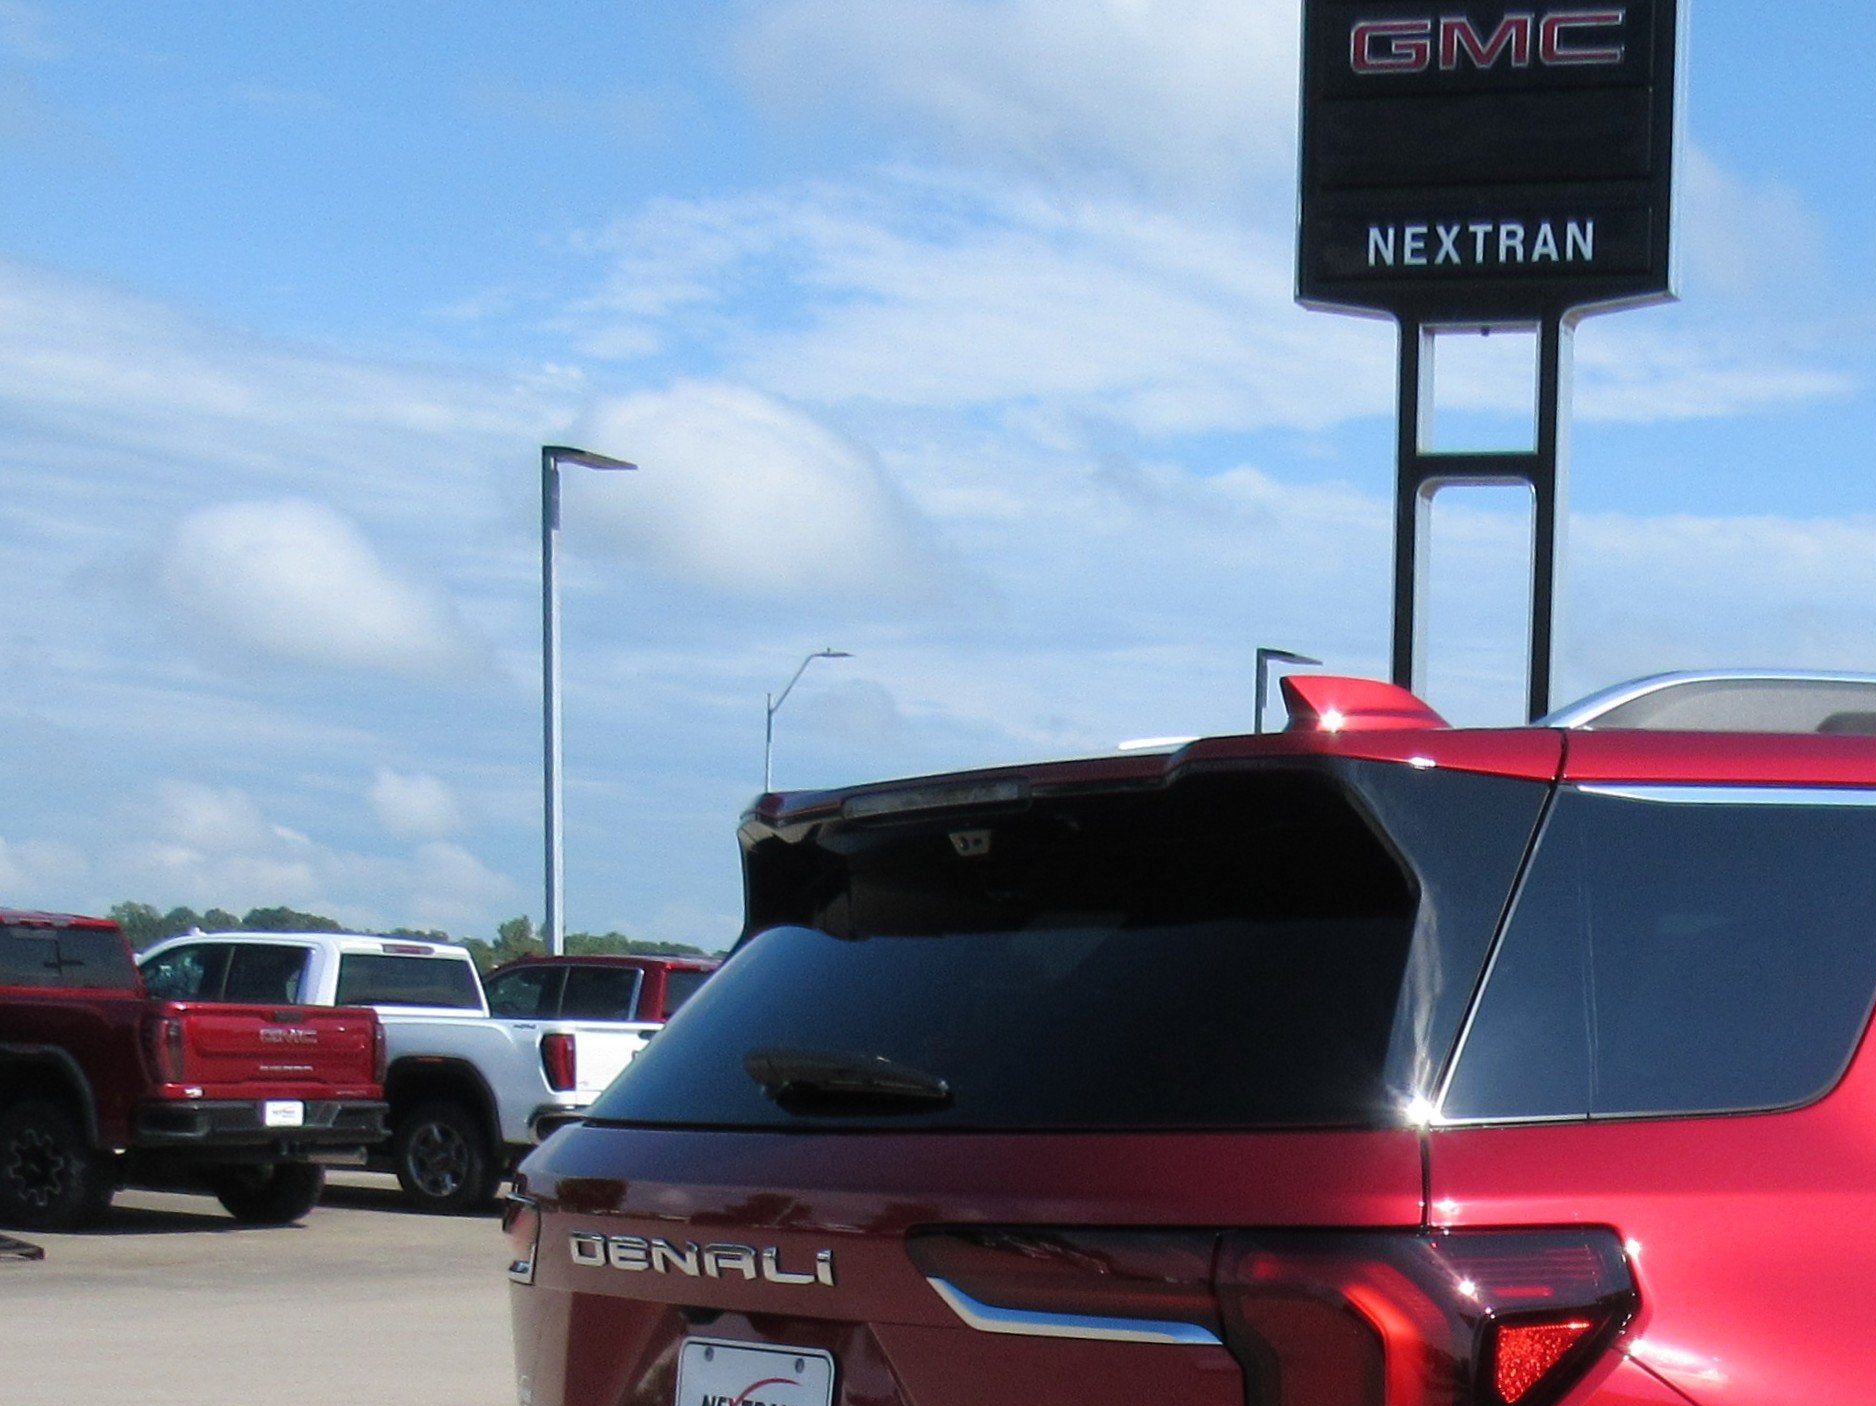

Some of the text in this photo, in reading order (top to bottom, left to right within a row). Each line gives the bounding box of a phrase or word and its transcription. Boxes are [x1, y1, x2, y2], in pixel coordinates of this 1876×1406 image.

[1350, 9, 1626, 75] GMC
[1367, 219, 1595, 267] NEXTRAN
[569, 1231, 835, 1286] DENALI
